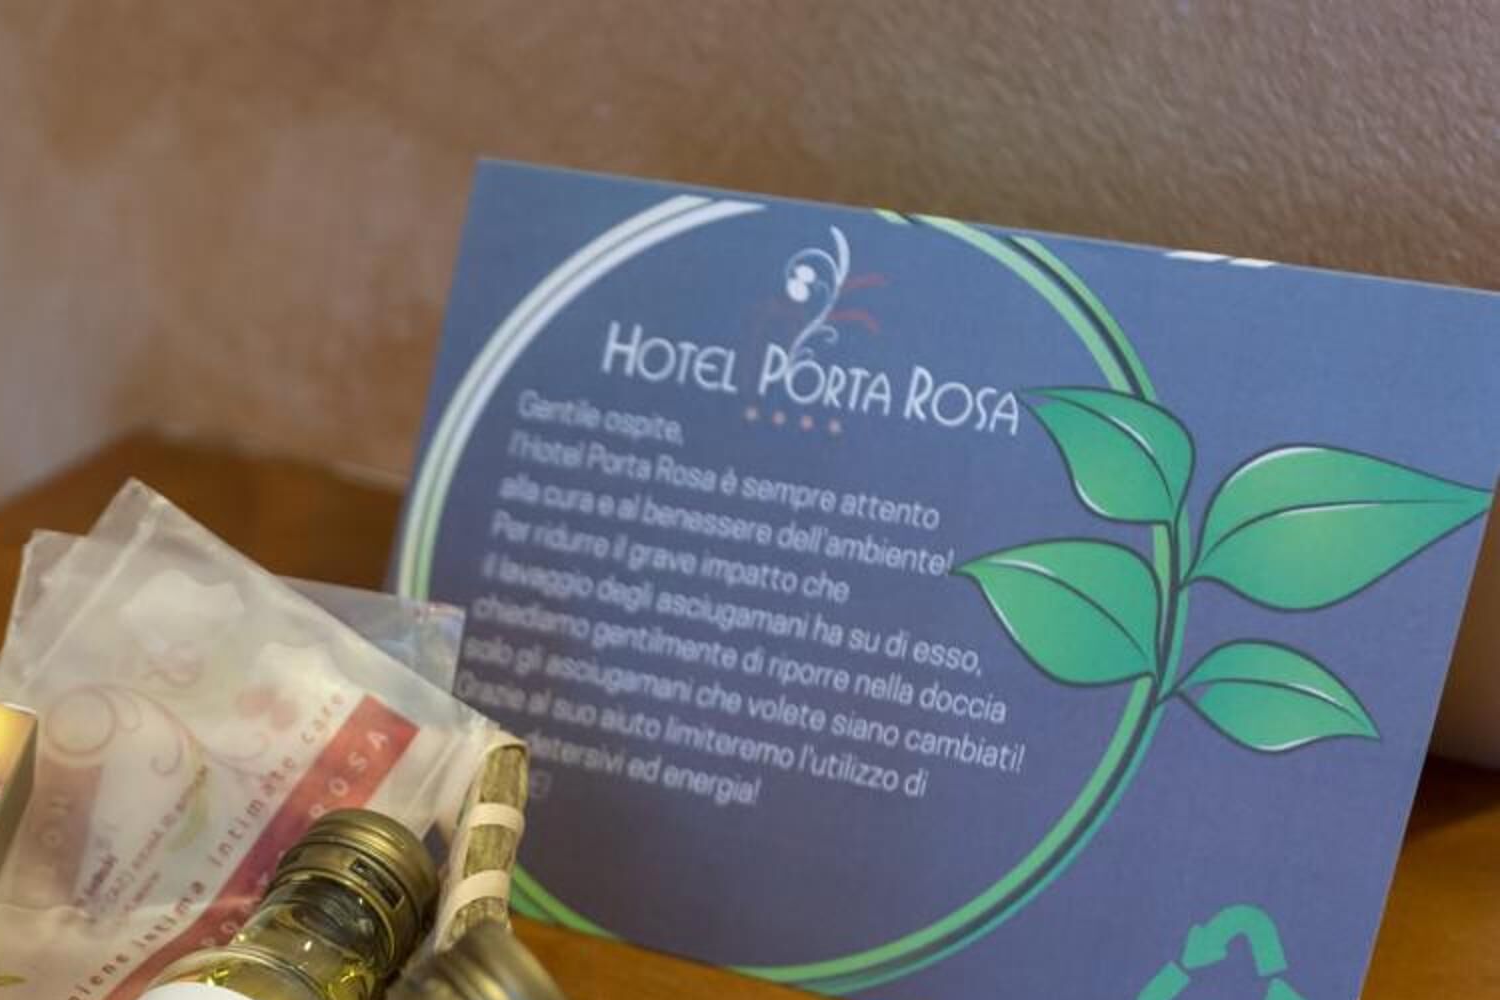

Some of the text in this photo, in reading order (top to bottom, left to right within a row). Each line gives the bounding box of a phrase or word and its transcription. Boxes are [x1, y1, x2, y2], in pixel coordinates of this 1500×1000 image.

[518, 389, 600, 428] Gentile
[602, 320, 1020, 437] HOTEL PORTA ROSA
[500, 472, 954, 577] alla cura e al benessere dell'ambiente!
[586, 441, 650, 481] Porta
[656, 453, 717, 492] Rosa
[742, 476, 836, 512] sempre
[841, 491, 940, 530] attento
[491, 509, 849, 603] Per ridurre il grave impatto che
[500, 553, 594, 600] lavaggio
[597, 576, 653, 613] degli
[656, 593, 807, 640] asciugamani
[813, 613, 843, 647] ha
[850, 627, 880, 653] su
[885, 629, 909, 659] di
[473, 596, 1007, 724] chiediamo gentilmente di riporre nella doccia
[515, 644, 542, 676] gli
[546, 654, 694, 703] asciugamani
[696, 681, 742, 713] che
[748, 695, 826, 731] volete
[831, 711, 899, 747] siano
[904, 729, 1026, 773] cambiati!
[528, 691, 551, 715] al
[552, 699, 597, 726] suo
[601, 704, 661, 738] aiuto
[664, 715, 794, 768] limiteremo
[800, 743, 898, 792] l'utilizzo
[904, 768, 929, 797] di
[627, 755, 661, 782] ed
[663, 770, 762, 805] energia!
[132, 880, 206, 949] intima
[207, 756, 297, 867] intimate
